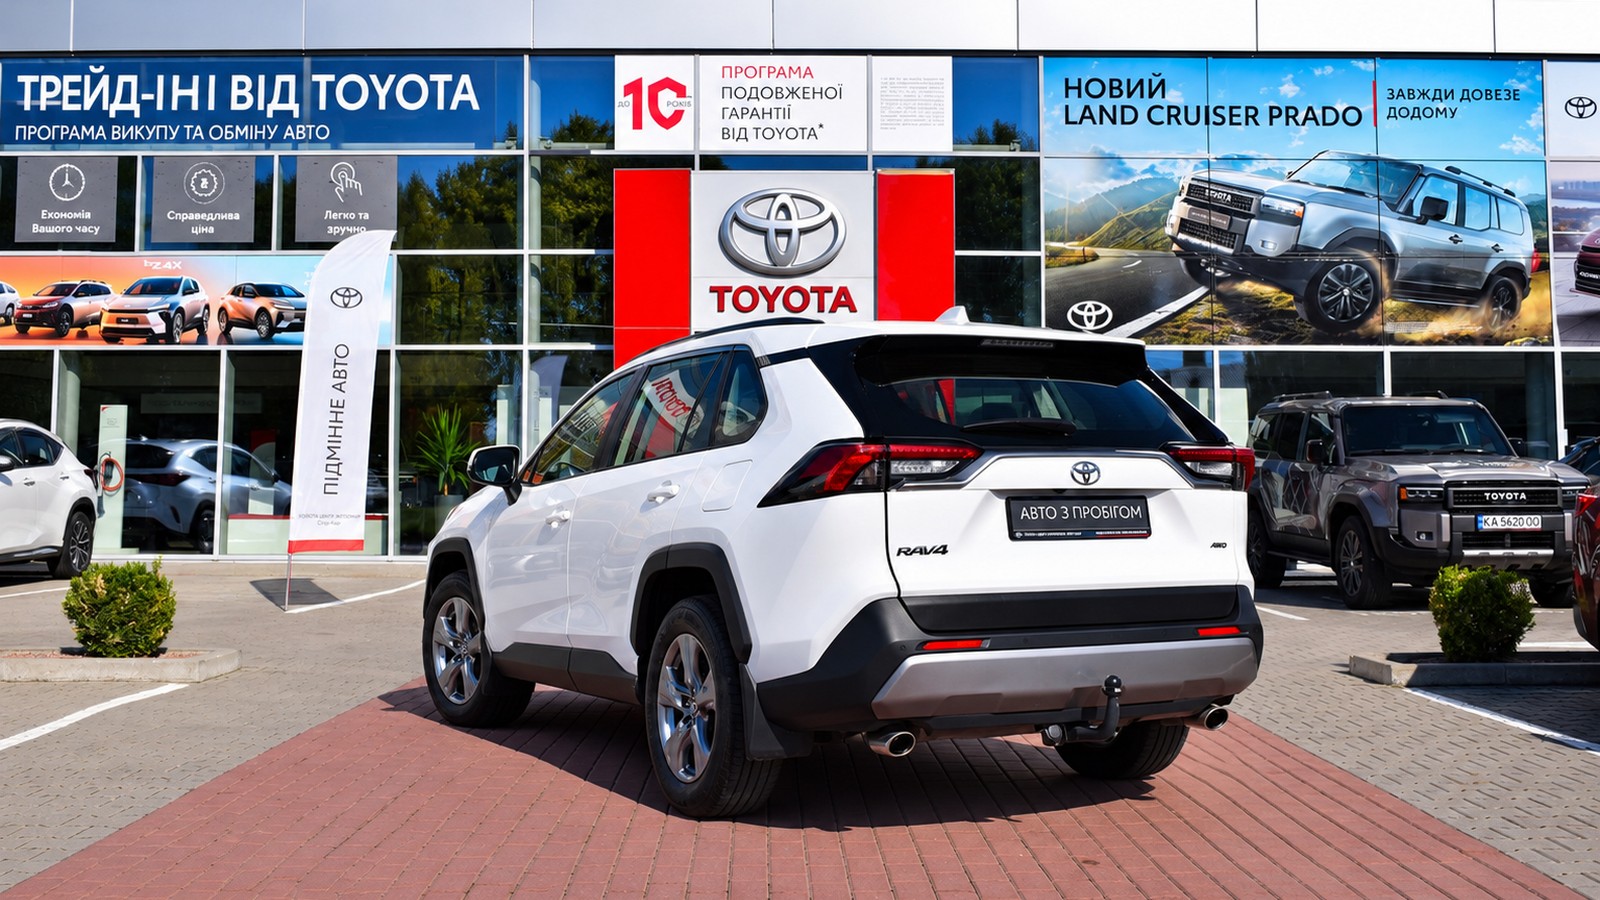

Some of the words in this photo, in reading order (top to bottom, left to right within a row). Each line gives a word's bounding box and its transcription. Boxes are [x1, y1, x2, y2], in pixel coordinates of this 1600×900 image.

[721, 66, 814, 79] ПРОГРАМА
[721, 83, 843, 101] ПОДОВЖЕНОЇ
[1064, 72, 1166, 99] НОВИЙ
[230, 74, 299, 118] ВІД
[312, 73, 480, 111] TOYOTA
[623, 76, 687, 130] 10
[1386, 88, 1455, 102] ЗАВЖДИ
[1459, 88, 1521, 103] ДОВЕЗЕ
[721, 104, 791, 120] ГАРАНТІЇ
[1064, 105, 1139, 125] LAND
[1146, 105, 1260, 126] CRUISER
[1268, 106, 1363, 127] PRADO
[1386, 106, 1458, 120] ДОДОМУ
[15, 125, 107, 141] ПРОГРАМА
[111, 125, 180, 141] ВИКУПУ
[183, 125, 204, 140] ТА
[208, 124, 278, 141] ОБМІНУ
[283, 124, 330, 140] АВТО
[721, 127, 748, 142] ВІД
[41, 209, 91, 220] Економія
[167, 210, 240, 222] Справедлива
[324, 210, 356, 220] Легко
[358, 211, 370, 220] та
[32, 223, 73, 234] Вашого
[77, 225, 100, 236] часу
[191, 224, 215, 235] ціна
[327, 225, 367, 236] зручно
[709, 285, 858, 313] TOYOTA
[332, 343, 350, 394] АВТО
[323, 398, 345, 495] ПІДМІННЕ
[1484, 492, 1527, 500] TOYOTA
[1020, 505, 1057, 520] АВТО
[1061, 506, 1069, 519] З
[1072, 505, 1142, 519] ПРОБІГОМ
[1483, 517, 1498, 527] KA
[1500, 516, 1524, 527] 5620
[896, 544, 949, 557] RAV4
